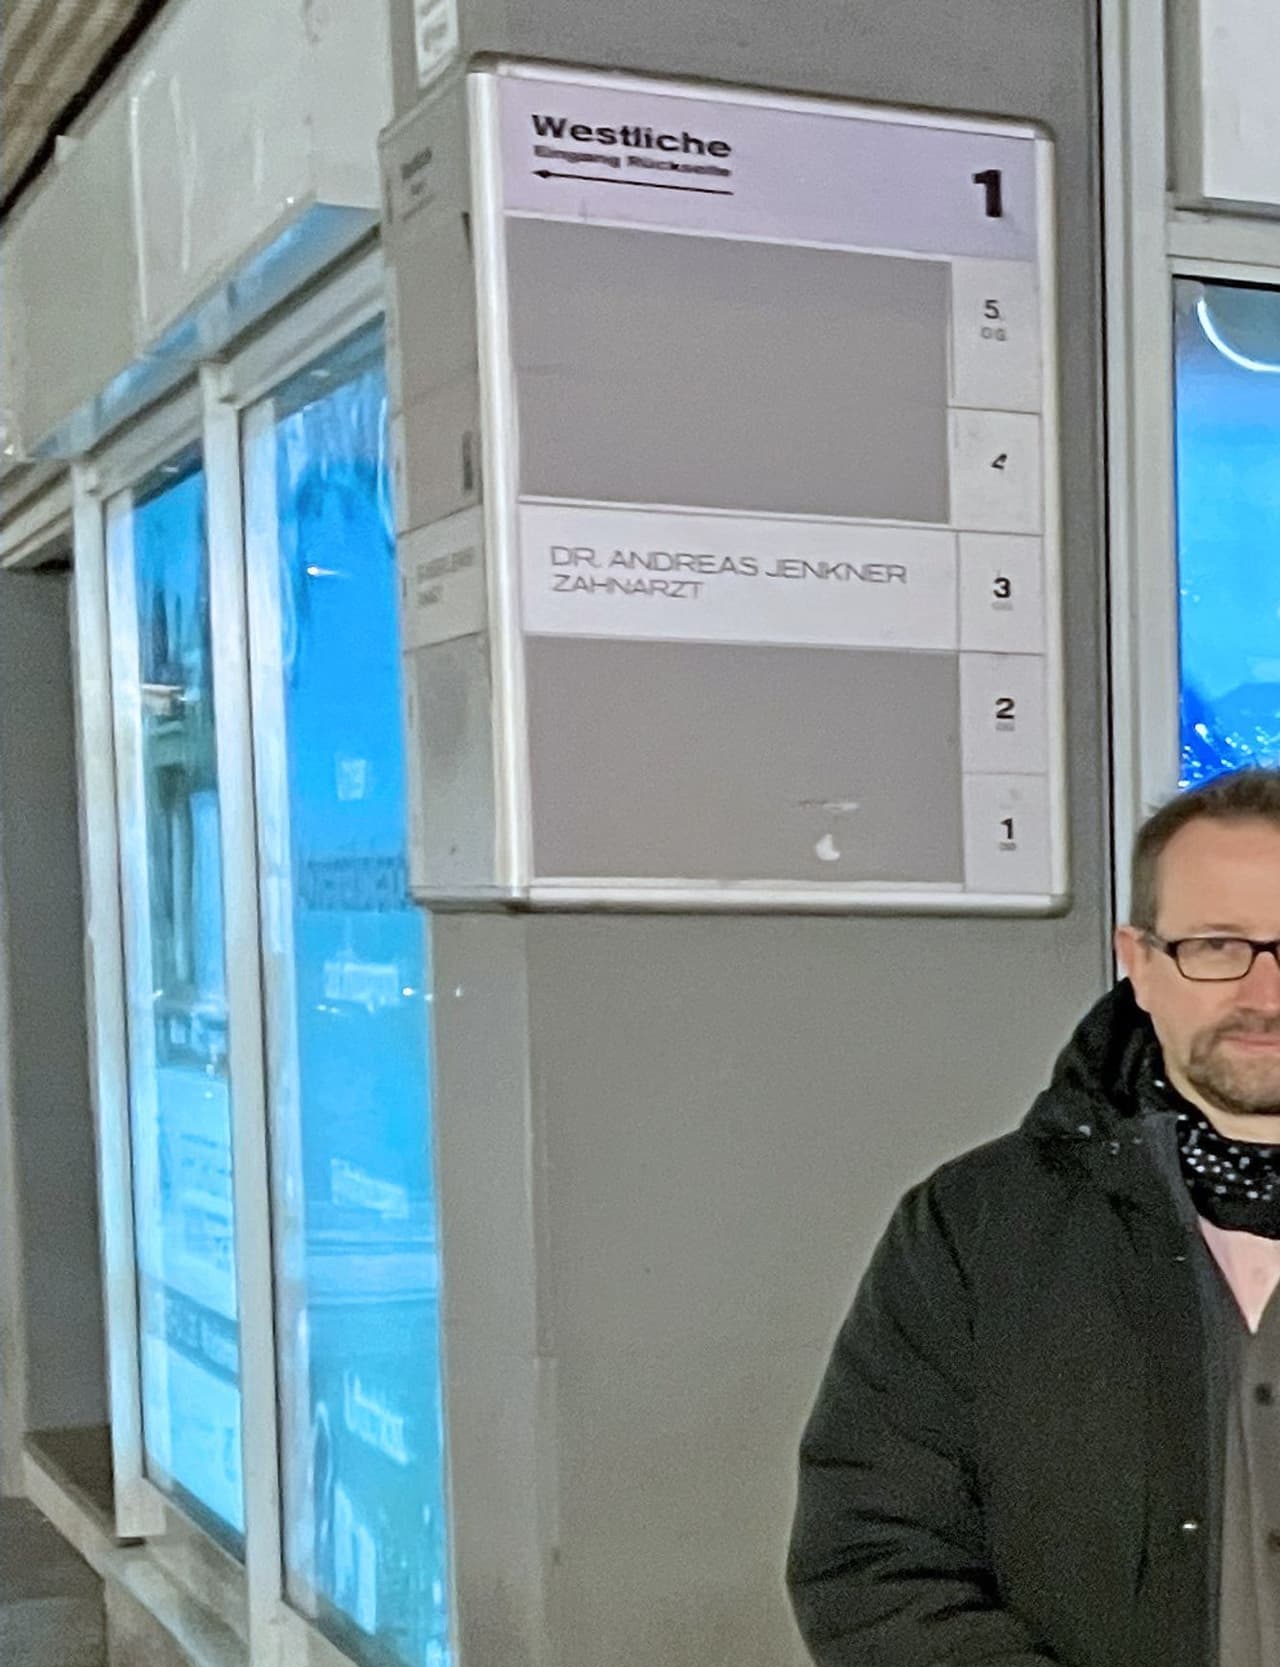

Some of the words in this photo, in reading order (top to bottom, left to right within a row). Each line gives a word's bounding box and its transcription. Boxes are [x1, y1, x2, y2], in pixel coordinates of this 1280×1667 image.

[532, 114, 731, 157] Westliche
[972, 169, 1003, 218] 1
[608, 550, 759, 577] ANDREAS
[765, 558, 907, 583] JENKNER
[552, 574, 704, 598] ZAHNARZT
[993, 577, 1012, 599] 3
[995, 697, 1015, 720] 2
[1000, 818, 1014, 839] 1
